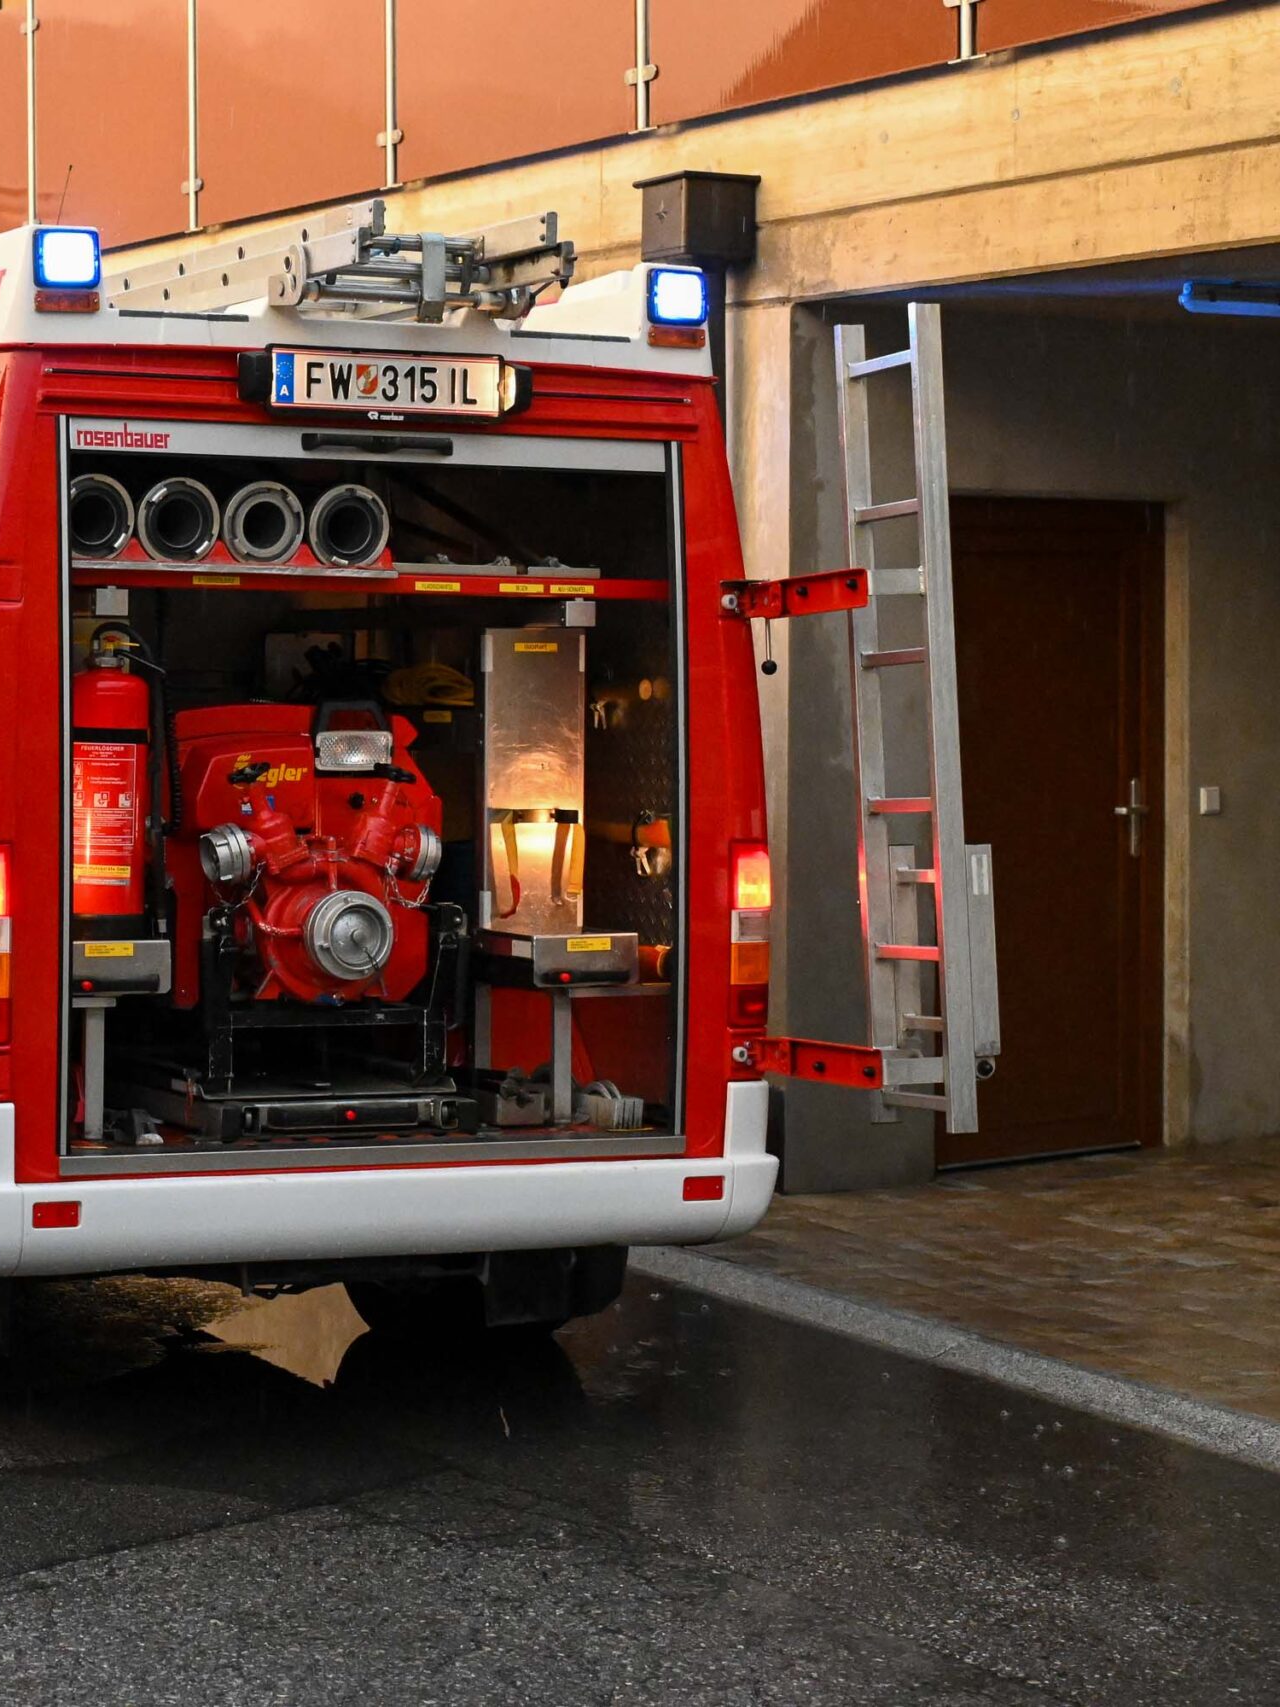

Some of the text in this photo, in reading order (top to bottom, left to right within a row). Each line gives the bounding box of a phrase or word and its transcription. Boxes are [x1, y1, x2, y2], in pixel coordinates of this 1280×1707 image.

[280, 385, 289, 396] A
[306, 362, 478, 405] FW 315 IL
[76, 421, 170, 449] rosenbauer
[233, 752, 308, 788] gler
